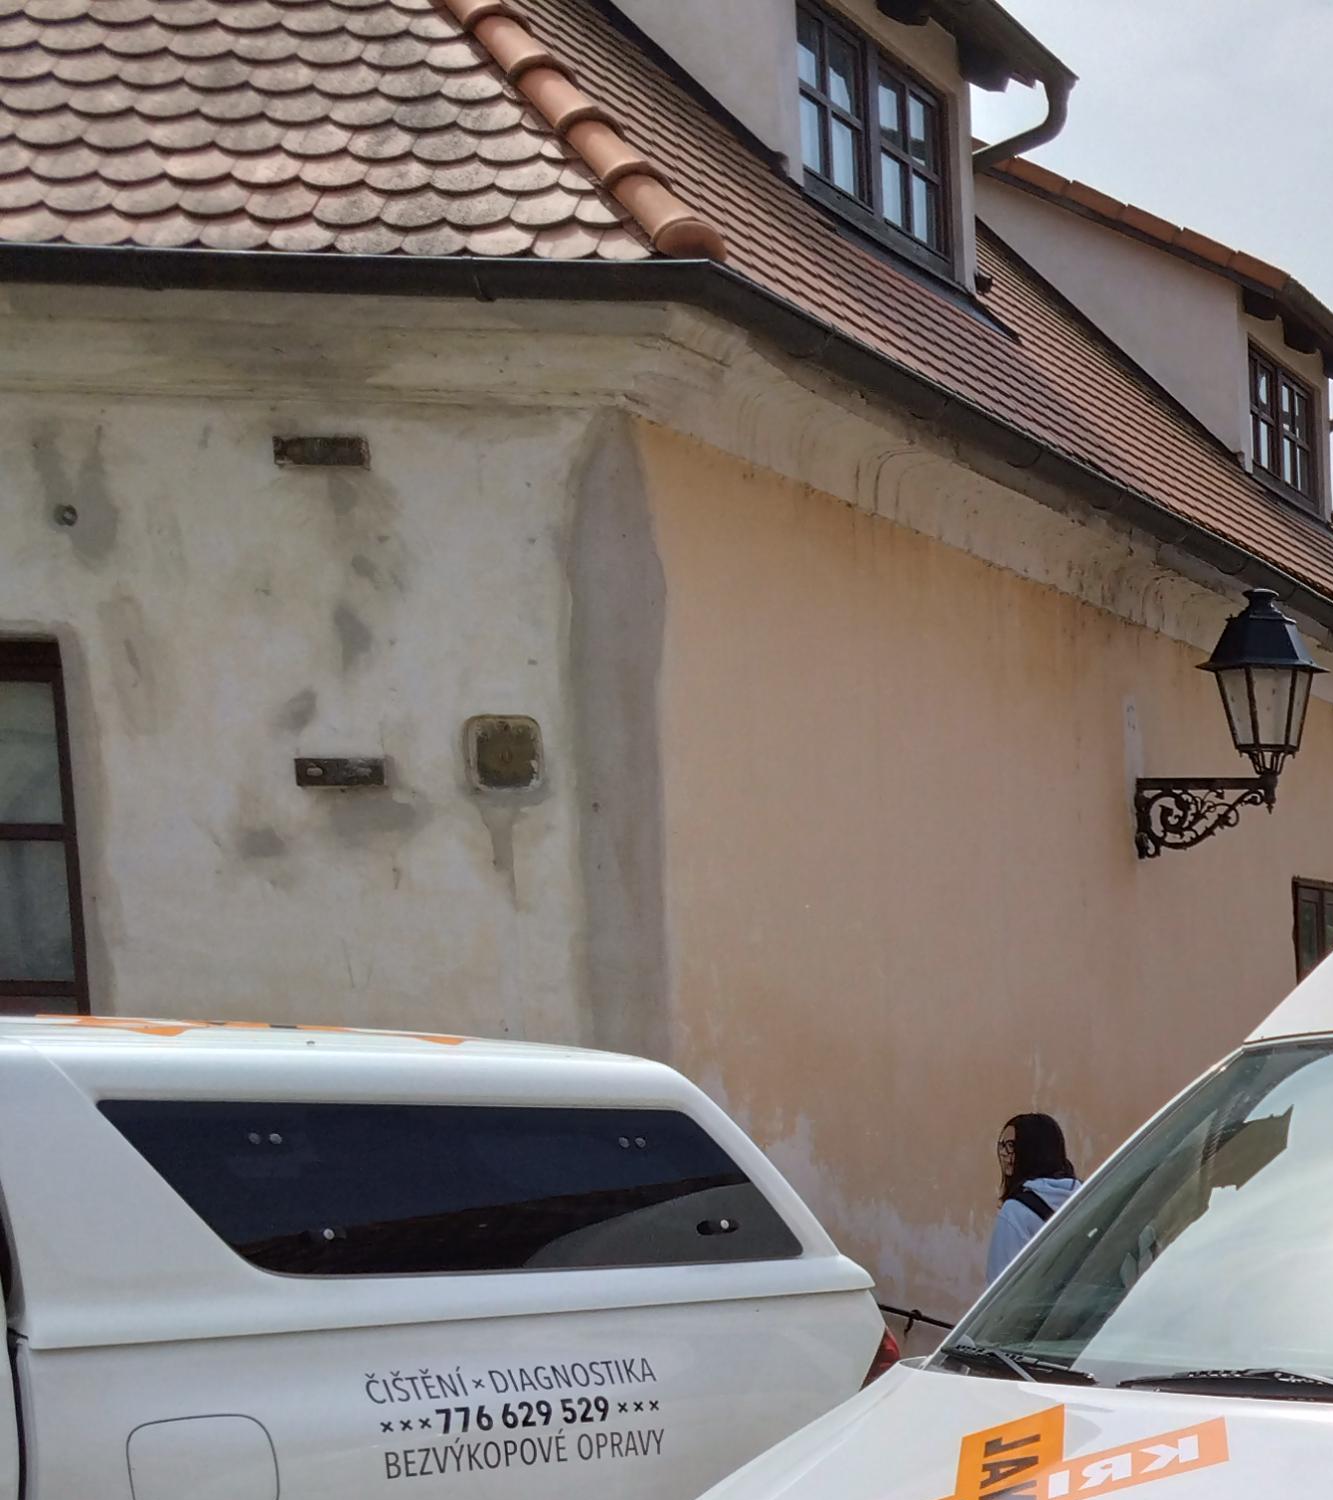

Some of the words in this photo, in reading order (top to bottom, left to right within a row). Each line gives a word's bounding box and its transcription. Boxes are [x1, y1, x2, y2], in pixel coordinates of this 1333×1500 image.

[364, 1366, 469, 1405] ČIŠTĚNÍ
[487, 1357, 657, 1394] DIAGNOSTIKA
[435, 1405, 494, 1434] 776
[501, 1400, 552, 1429] 629
[560, 1396, 609, 1424] 529
[384, 1428, 568, 1480] BEZVÝKOPOVÉ
[577, 1428, 665, 1461] OPRAVY
